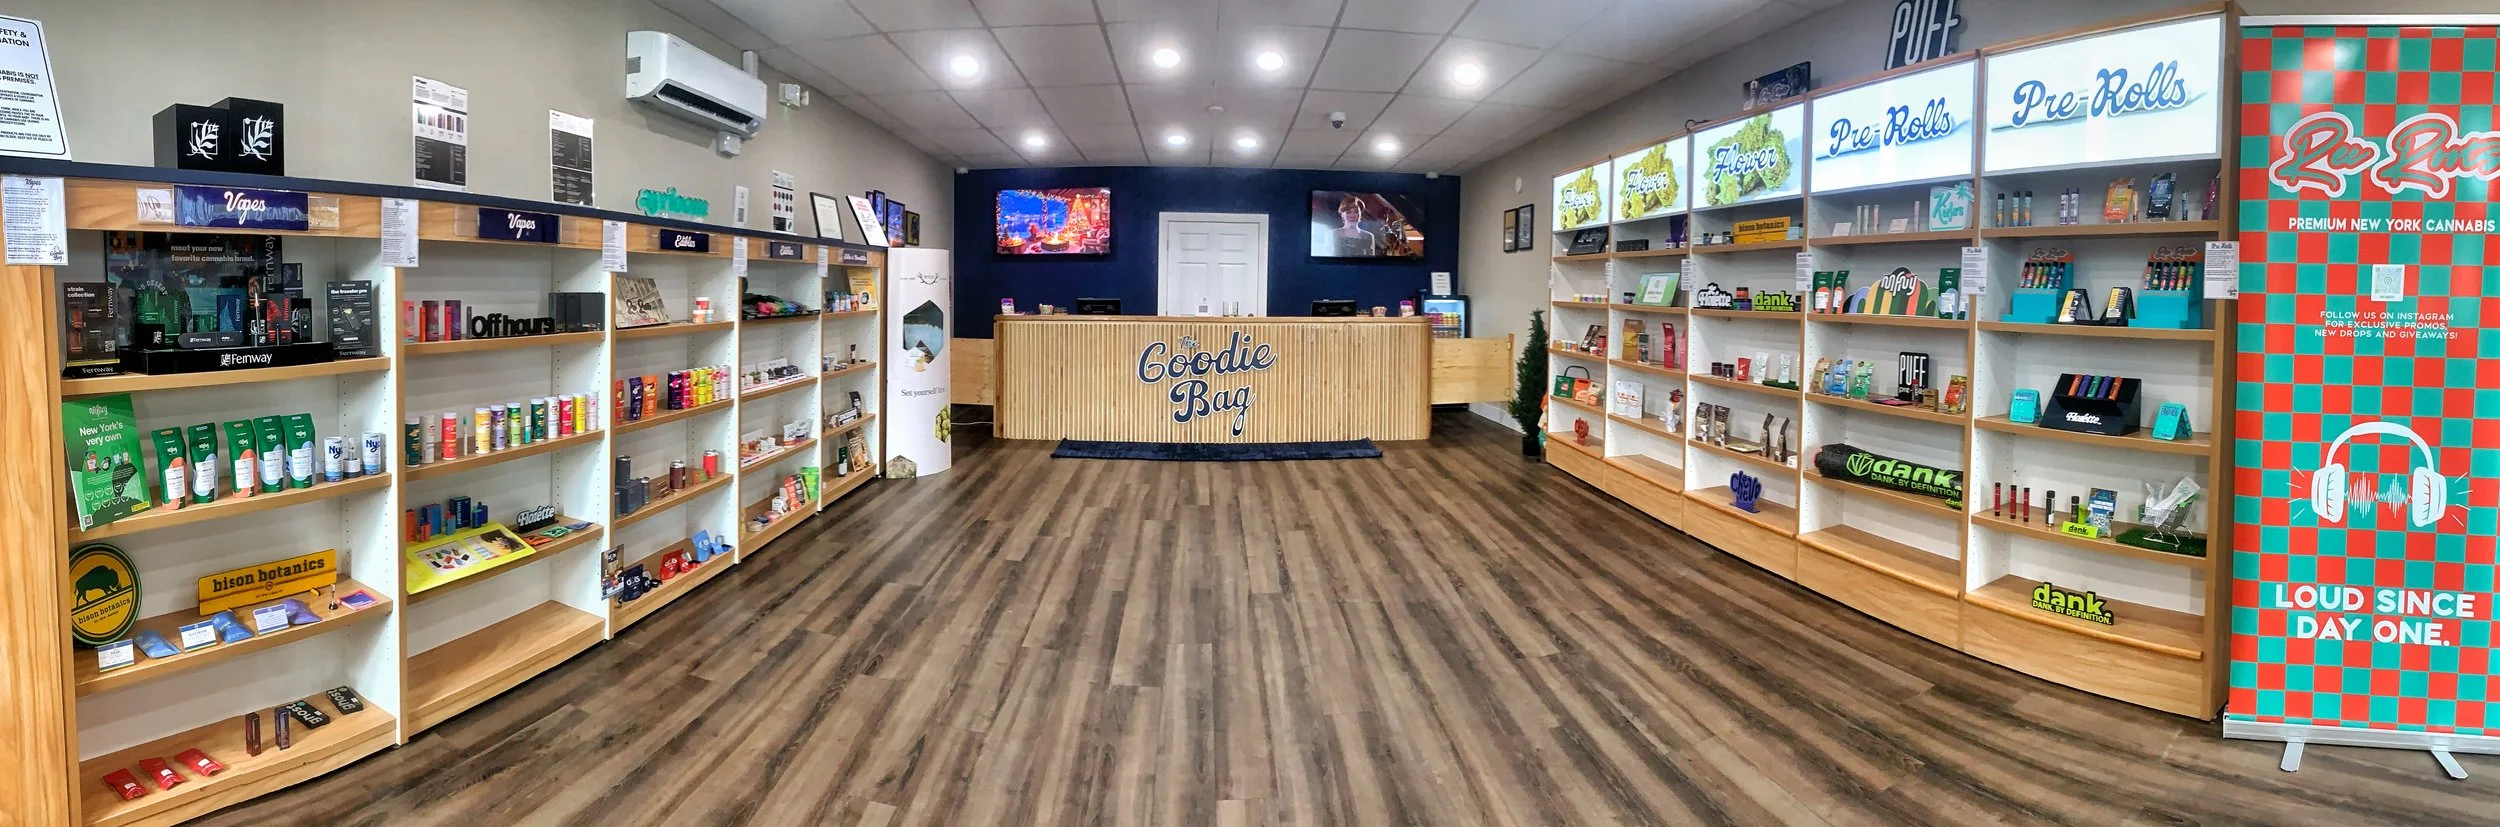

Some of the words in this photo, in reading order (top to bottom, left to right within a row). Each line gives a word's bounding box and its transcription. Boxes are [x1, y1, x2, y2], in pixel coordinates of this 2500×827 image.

[1886, 0, 1959, 69] PUFF
[2011, 60, 2187, 128] Pre-Rolls
[1829, 97, 1951, 157] Pre-Rolls
[1713, 143, 1779, 184] Flower
[1625, 168, 1669, 200] Flower
[224, 191, 266, 225] Vapes
[1562, 188, 1595, 212] Flower
[508, 213, 536, 239] Vapes
[2288, 218, 2346, 230] PREMIUM
[2350, 218, 2381, 230] NEW
[2385, 219, 2422, 231] YORK
[2426, 220, 2496, 232] CANNABIS
[172, 254, 200, 262] favorite
[1754, 291, 1794, 306] dank.
[471, 313, 502, 337] Off
[502, 315, 555, 336] hours
[2320, 311, 2360, 319] FOLLOW
[2397, 312, 2454, 321] INSTAGRAM
[2347, 321, 2400, 329] EXCLUSIVE
[2404, 322, 2448, 330] PROMOS,
[1179, 336, 1200, 349] The
[2314, 329, 2336, 337] NEW
[2375, 330, 2396, 338] AND
[2399, 331, 2458, 339] GIVEAWAYS!
[232, 353, 272, 364] Fernway
[1137, 330, 1278, 384] Goodie
[1900, 354, 1927, 387] PUFF
[913, 388, 937, 397] yourself
[1169, 379, 1256, 437] Bag
[80, 426, 98, 437] New
[99, 421, 123, 433] York's
[86, 436, 103, 446] very
[105, 433, 122, 442] own
[1871, 472, 1897, 485] DANK.
[1898, 479, 1910, 487] BY
[1911, 482, 1961, 498] DEFINITION.
[1873, 460, 1963, 490] dank.
[213, 574, 254, 592] bison
[258, 558, 325, 582] botanics
[78, 612, 100, 625] bison
[100, 598, 132, 616] botanics
[2032, 582, 2112, 617] dank.
[2032, 600, 2055, 612] DANK.
[2056, 604, 2065, 614] BY
[2066, 606, 2112, 625] DEFINITION.
[2275, 584, 2364, 611] LOUD
[2376, 589, 2475, 618] SINCE
[2297, 616, 2363, 640] DAY
[2373, 621, 2450, 647] ONE.
[327, 689, 355, 710] ghost
[286, 703, 322, 724] ghost
